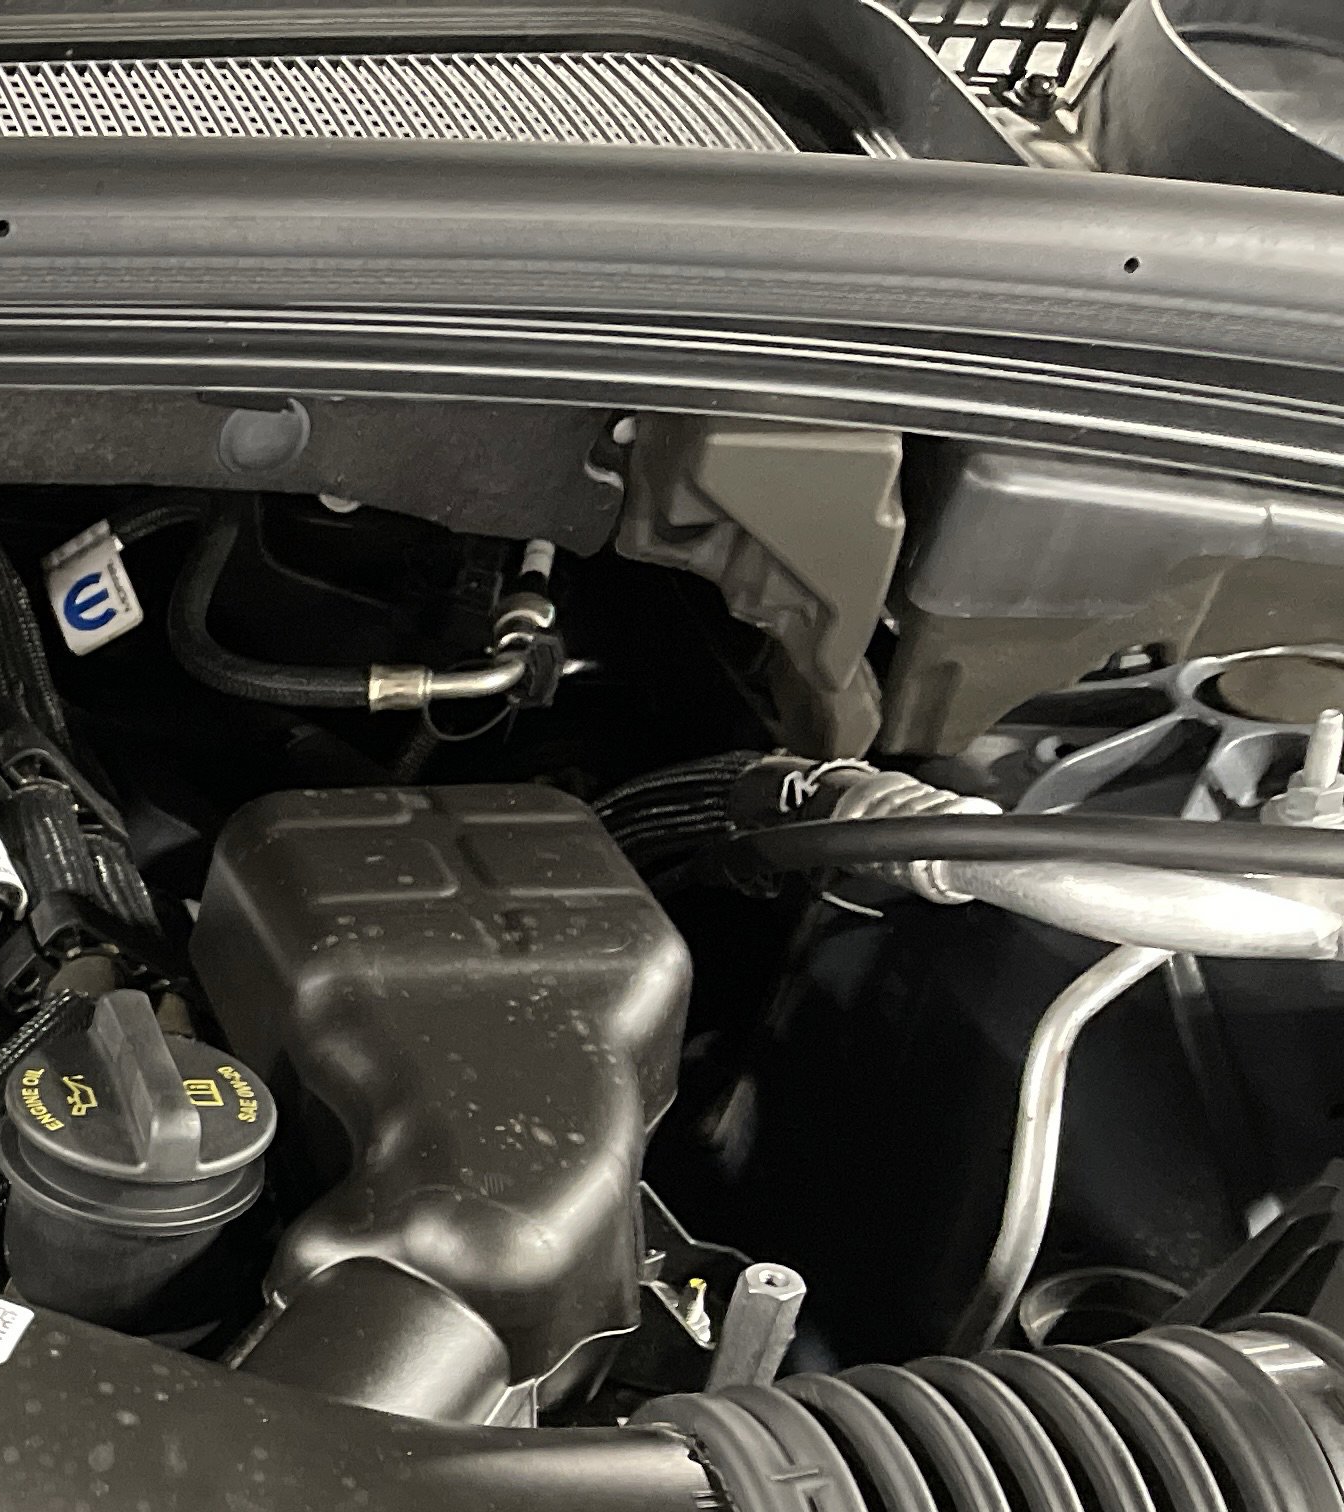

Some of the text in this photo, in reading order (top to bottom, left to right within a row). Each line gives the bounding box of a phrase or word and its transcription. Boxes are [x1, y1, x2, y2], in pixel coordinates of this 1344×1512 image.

[21, 1068, 65, 1131] ENGINE OIL
[237, 1099, 258, 1123] SAE
